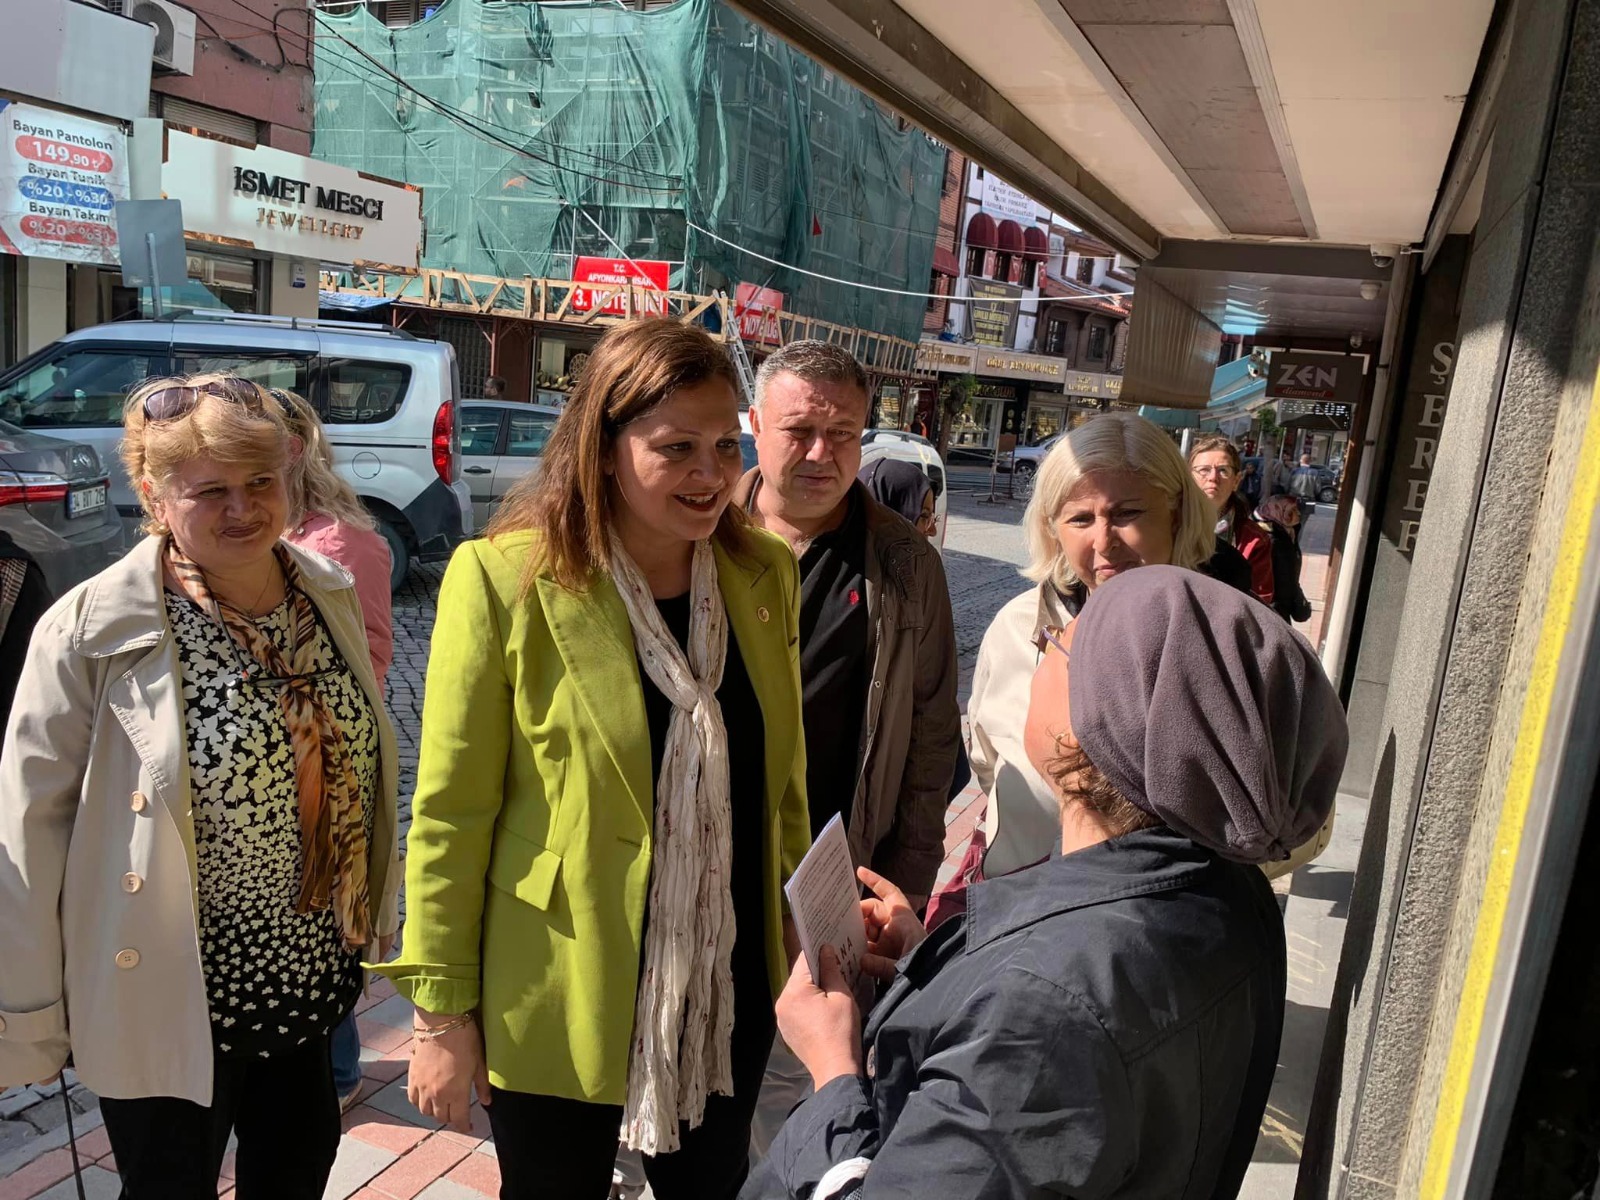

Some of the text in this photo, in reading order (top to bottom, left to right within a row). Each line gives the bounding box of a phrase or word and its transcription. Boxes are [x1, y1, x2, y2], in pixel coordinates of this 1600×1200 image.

[13, 119, 113, 151] Bayan Pantolon
[28, 162, 68, 179] Bayan
[26, 181, 63, 198] %20
[29, 201, 71, 217] Bayan
[575, 289, 588, 306] 3.
[1276, 364, 1338, 388] ZEN
